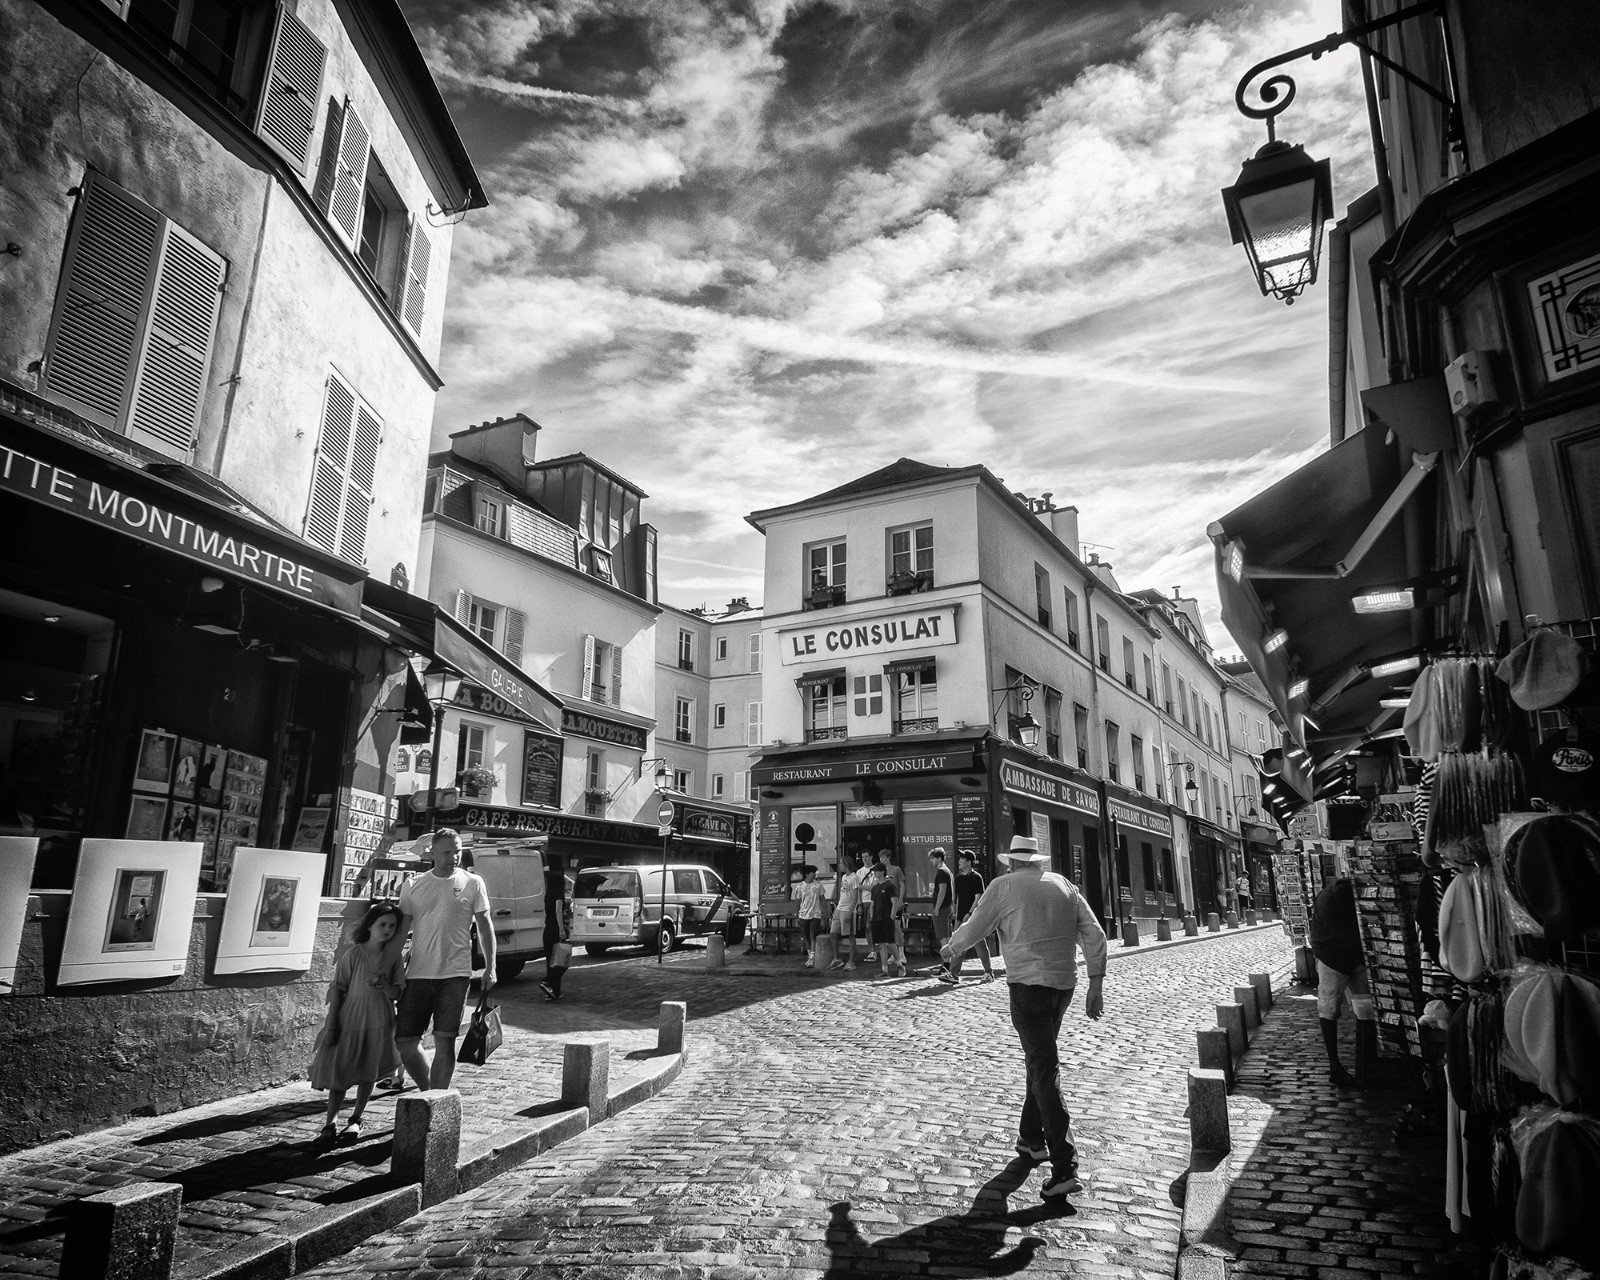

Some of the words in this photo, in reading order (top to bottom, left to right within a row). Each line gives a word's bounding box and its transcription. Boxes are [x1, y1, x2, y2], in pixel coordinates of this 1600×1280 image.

[87, 481, 315, 594] MONTMARTRE
[792, 634, 817, 657] LE
[825, 615, 942, 652] CONSULAT
[898, 664, 923, 672] CONSULAT
[802, 678, 830, 686] RESTAURANT
[773, 768, 832, 781] RESTAURANT
[855, 762, 871, 775] LE
[876, 756, 946, 773] CONSULAT
[1005, 767, 1056, 798] AMBASSADE
[1061, 787, 1071, 802] DE
[1075, 791, 1099, 811] SAVOIE
[515, 813, 610, 839] RESTAURANT
[698, 816, 719, 831] CAVE
[1108, 803, 1141, 825] RESTAURANT
[1141, 813, 1148, 826] LE
[1149, 817, 1171, 834] CONSULAT
